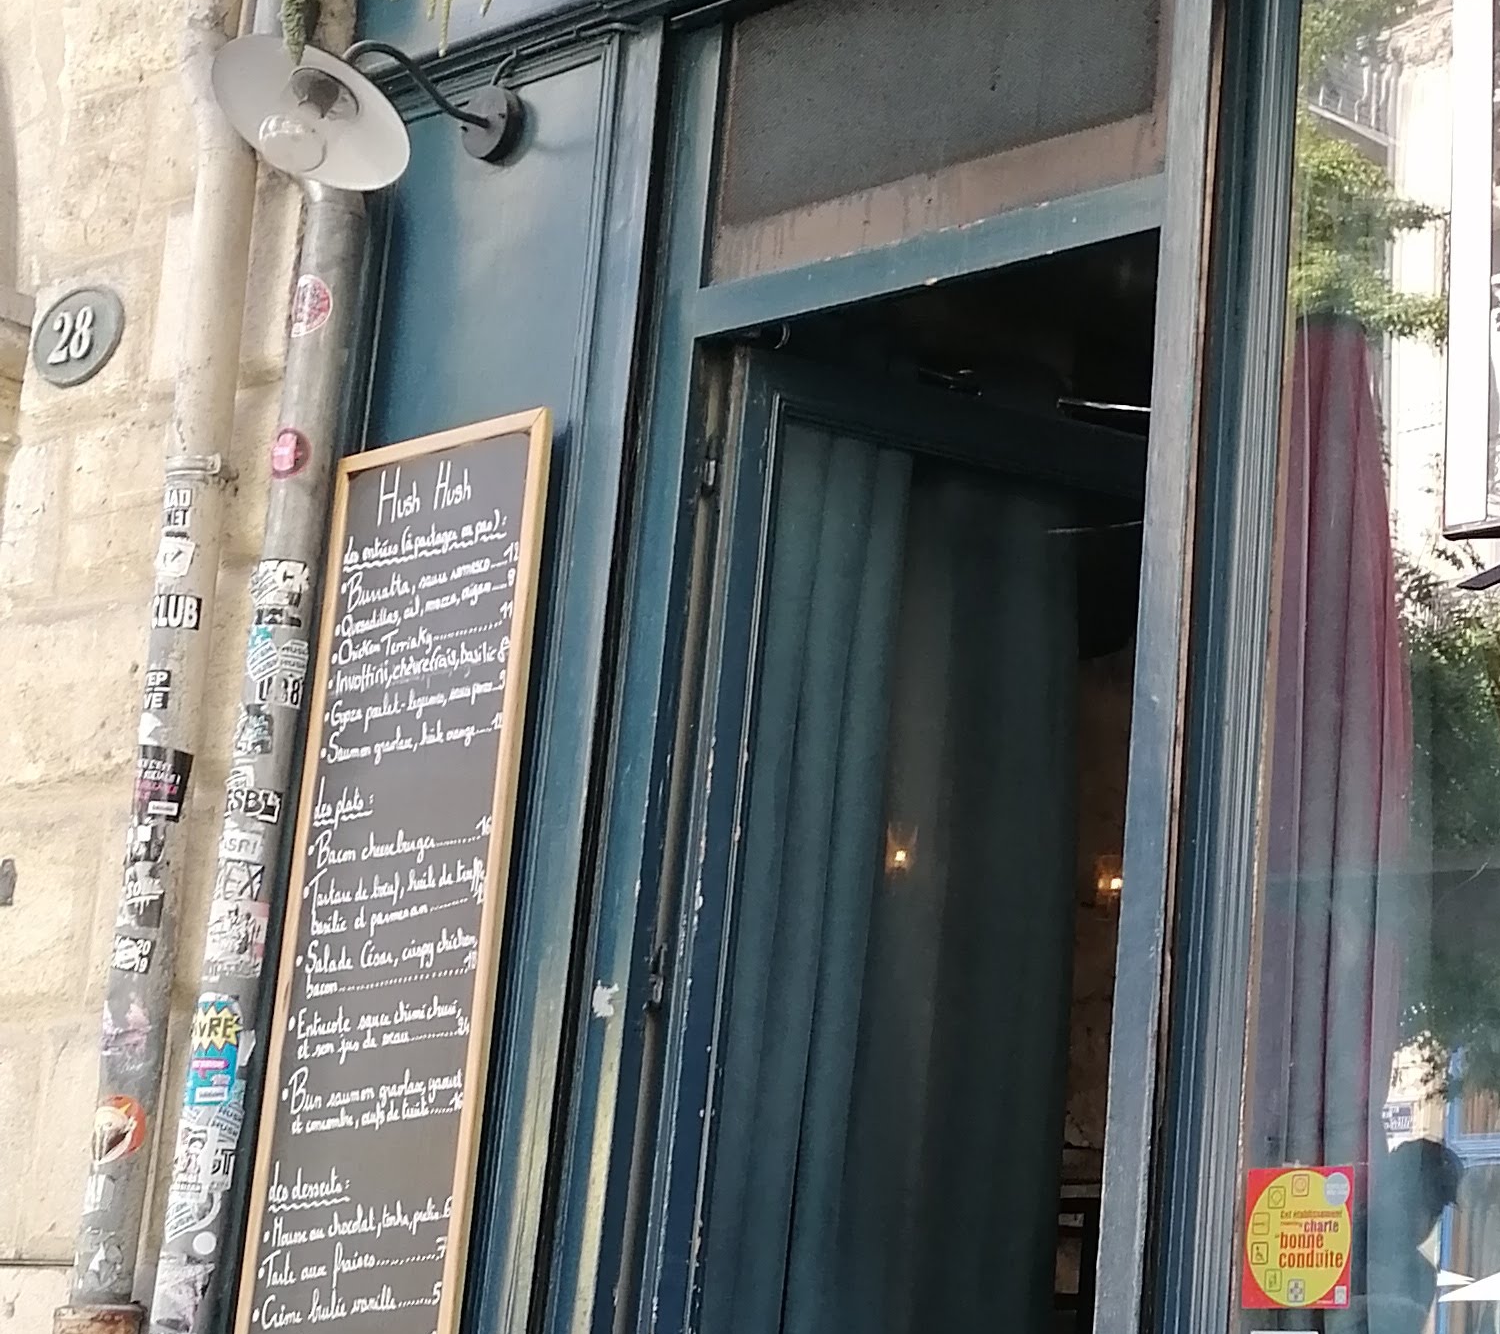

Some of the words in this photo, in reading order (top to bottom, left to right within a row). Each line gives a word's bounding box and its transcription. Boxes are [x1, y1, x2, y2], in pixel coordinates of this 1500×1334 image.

[47, 305, 96, 365] 28
[376, 465, 420, 528] Hush
[433, 460, 472, 511] Hush
[315, 829, 357, 869] Bacon
[304, 939, 354, 974] Salade
[306, 972, 338, 999] bacon
[1279, 1231, 1324, 1249] bonne
[1303, 1220, 1339, 1233] charte
[262, 1249, 297, 1289] Tarte
[1278, 1249, 1344, 1269] conduite
